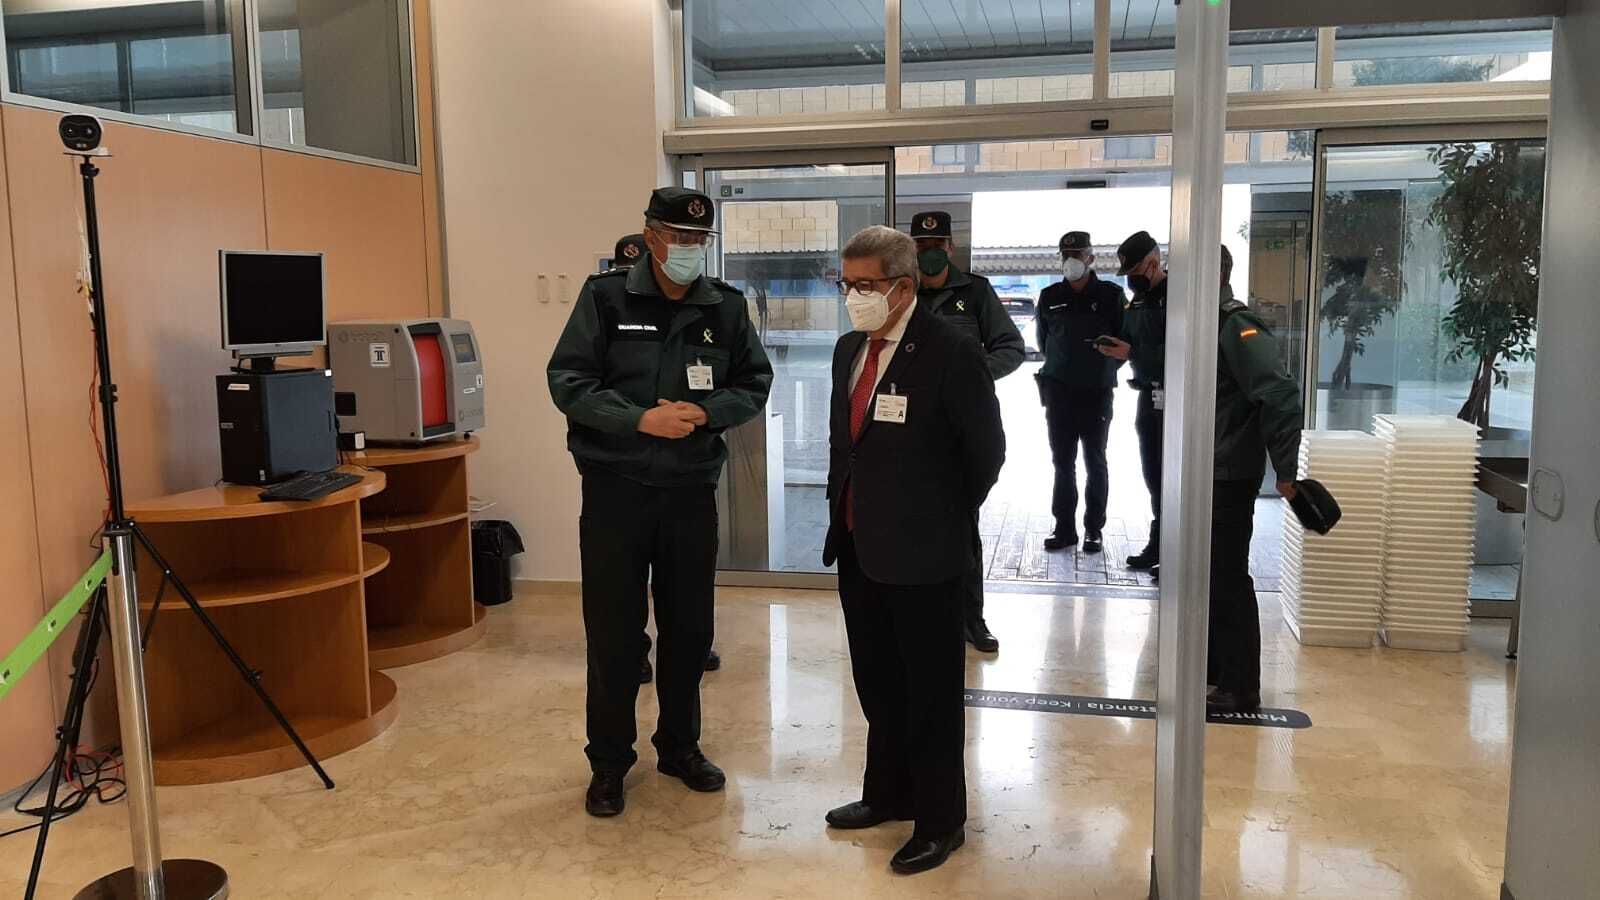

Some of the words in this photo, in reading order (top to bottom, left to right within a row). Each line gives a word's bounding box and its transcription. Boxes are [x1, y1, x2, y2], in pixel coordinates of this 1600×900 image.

[898, 410, 904, 418] A
[978, 695, 1018, 703] your
[1025, 696, 1071, 708] Keep
[1087, 702, 1157, 713] stancia
